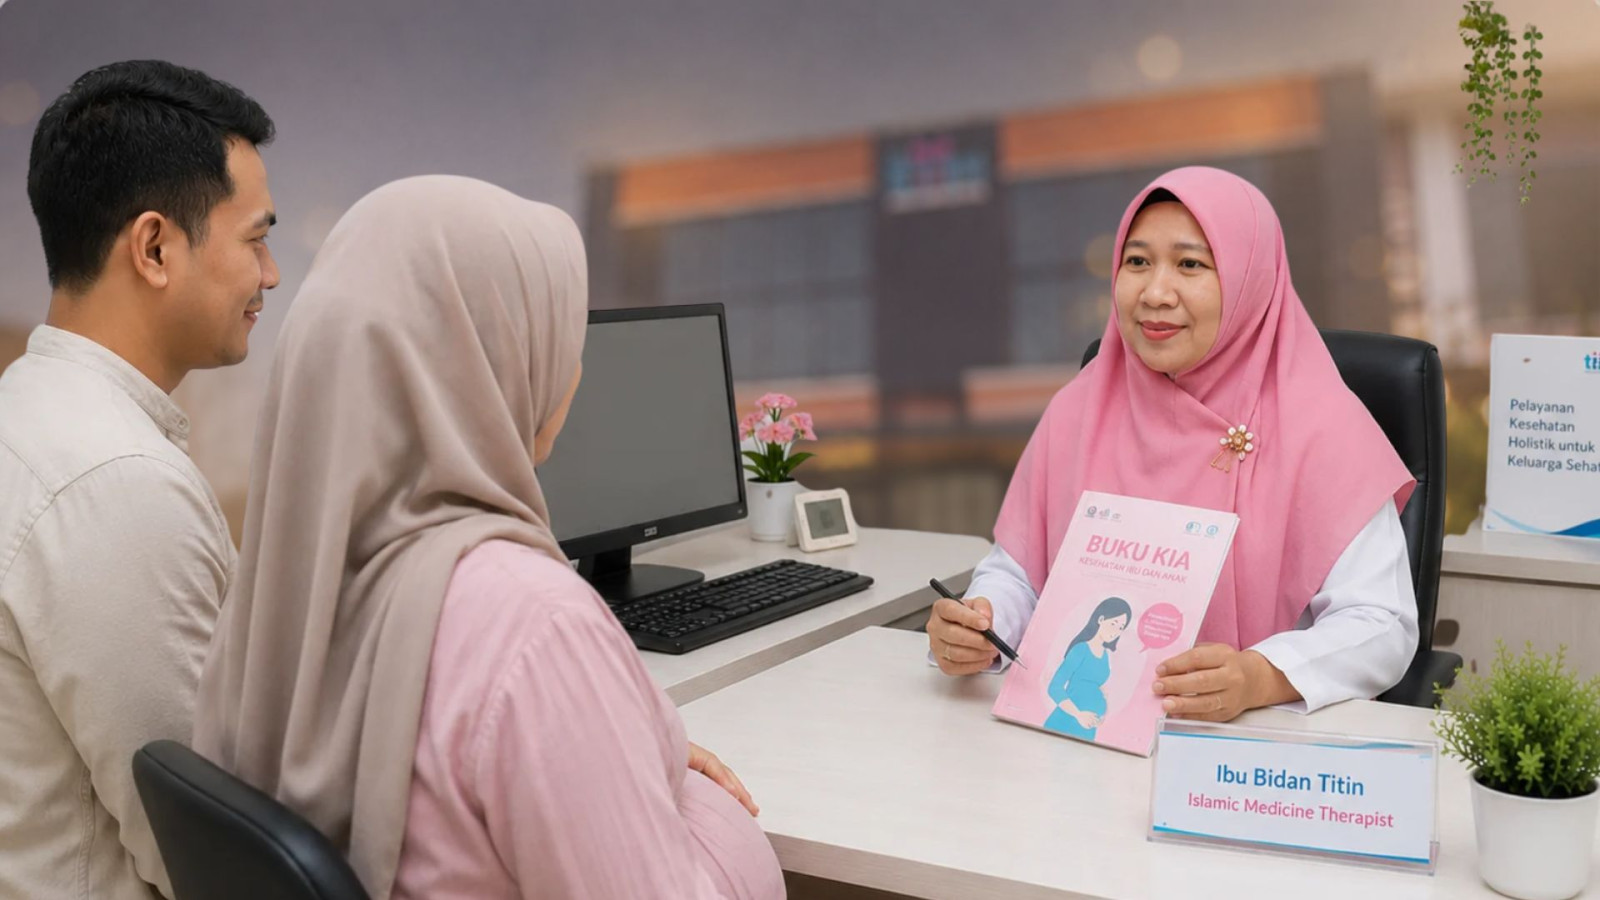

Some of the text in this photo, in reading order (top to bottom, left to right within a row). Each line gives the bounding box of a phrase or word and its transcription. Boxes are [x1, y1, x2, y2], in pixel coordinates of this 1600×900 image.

[1584, 351, 1600, 370] ti
[1510, 399, 1575, 415] Pelayanan
[1509, 418, 1575, 432] Kesehatan
[1508, 436, 1595, 453] Holistik untuk
[1507, 455, 1562, 472] Keluarga
[1086, 534, 1190, 571] BUKU KIA
[1216, 764, 1364, 796] Ibu Bidan Titin
[1188, 792, 1394, 829] Islamic Medicine Therapist
